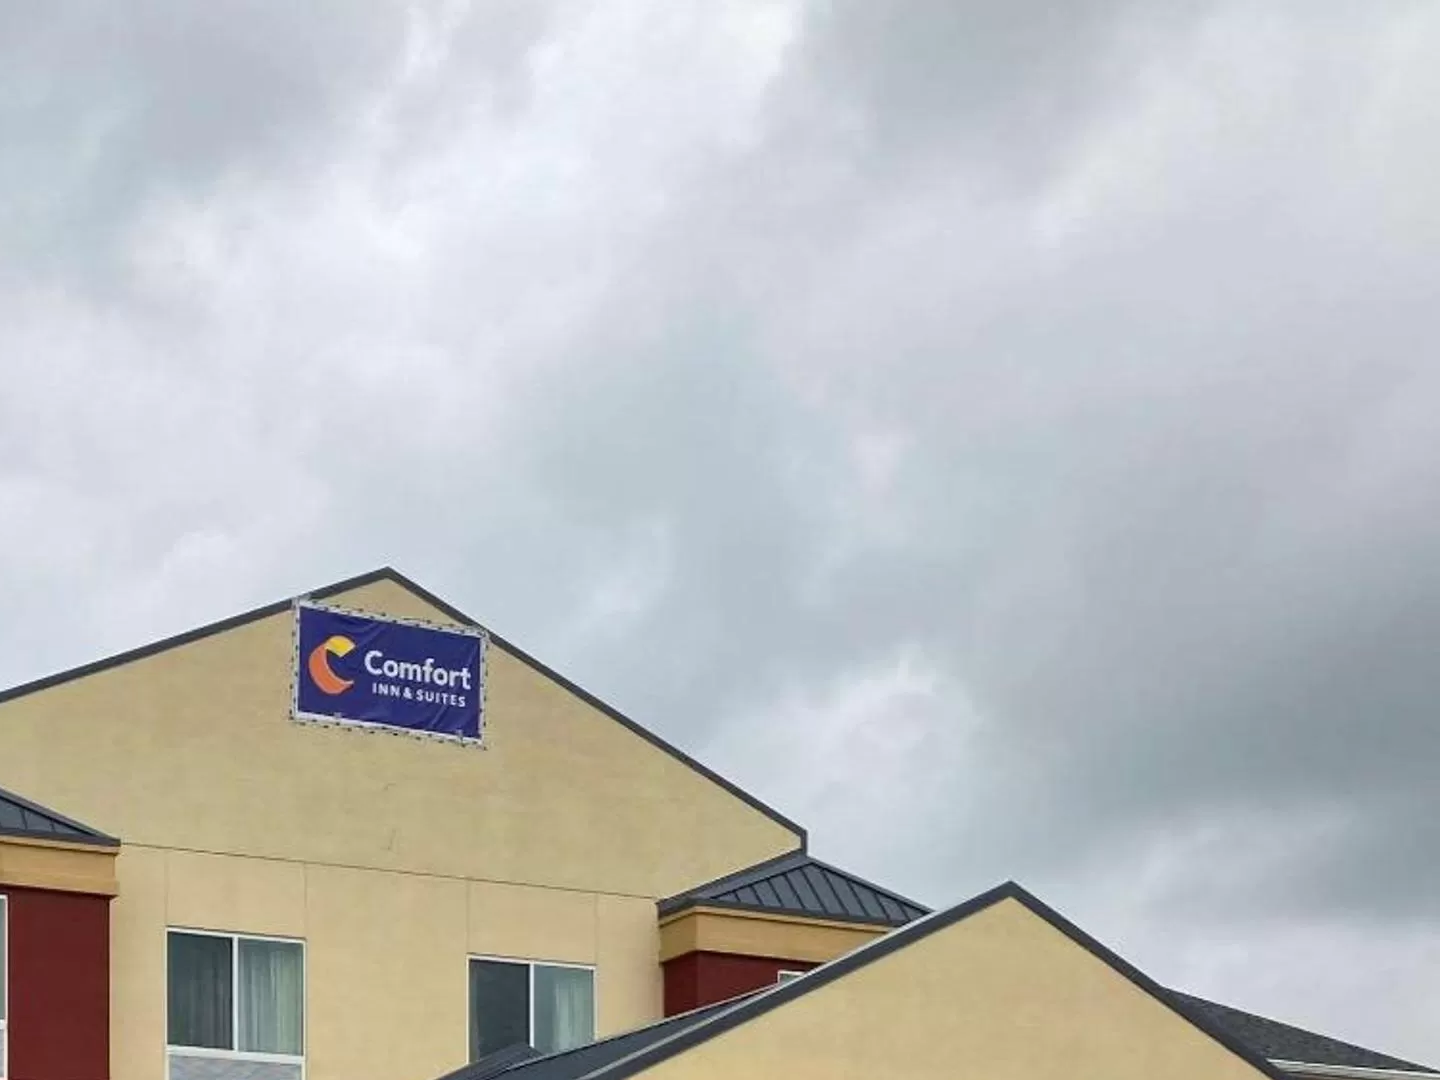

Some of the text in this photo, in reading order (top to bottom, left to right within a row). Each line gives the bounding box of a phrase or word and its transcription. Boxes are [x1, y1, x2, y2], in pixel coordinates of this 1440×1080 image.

[364, 650, 472, 690] Comfort
[372, 682, 466, 708] INN & SUITES
